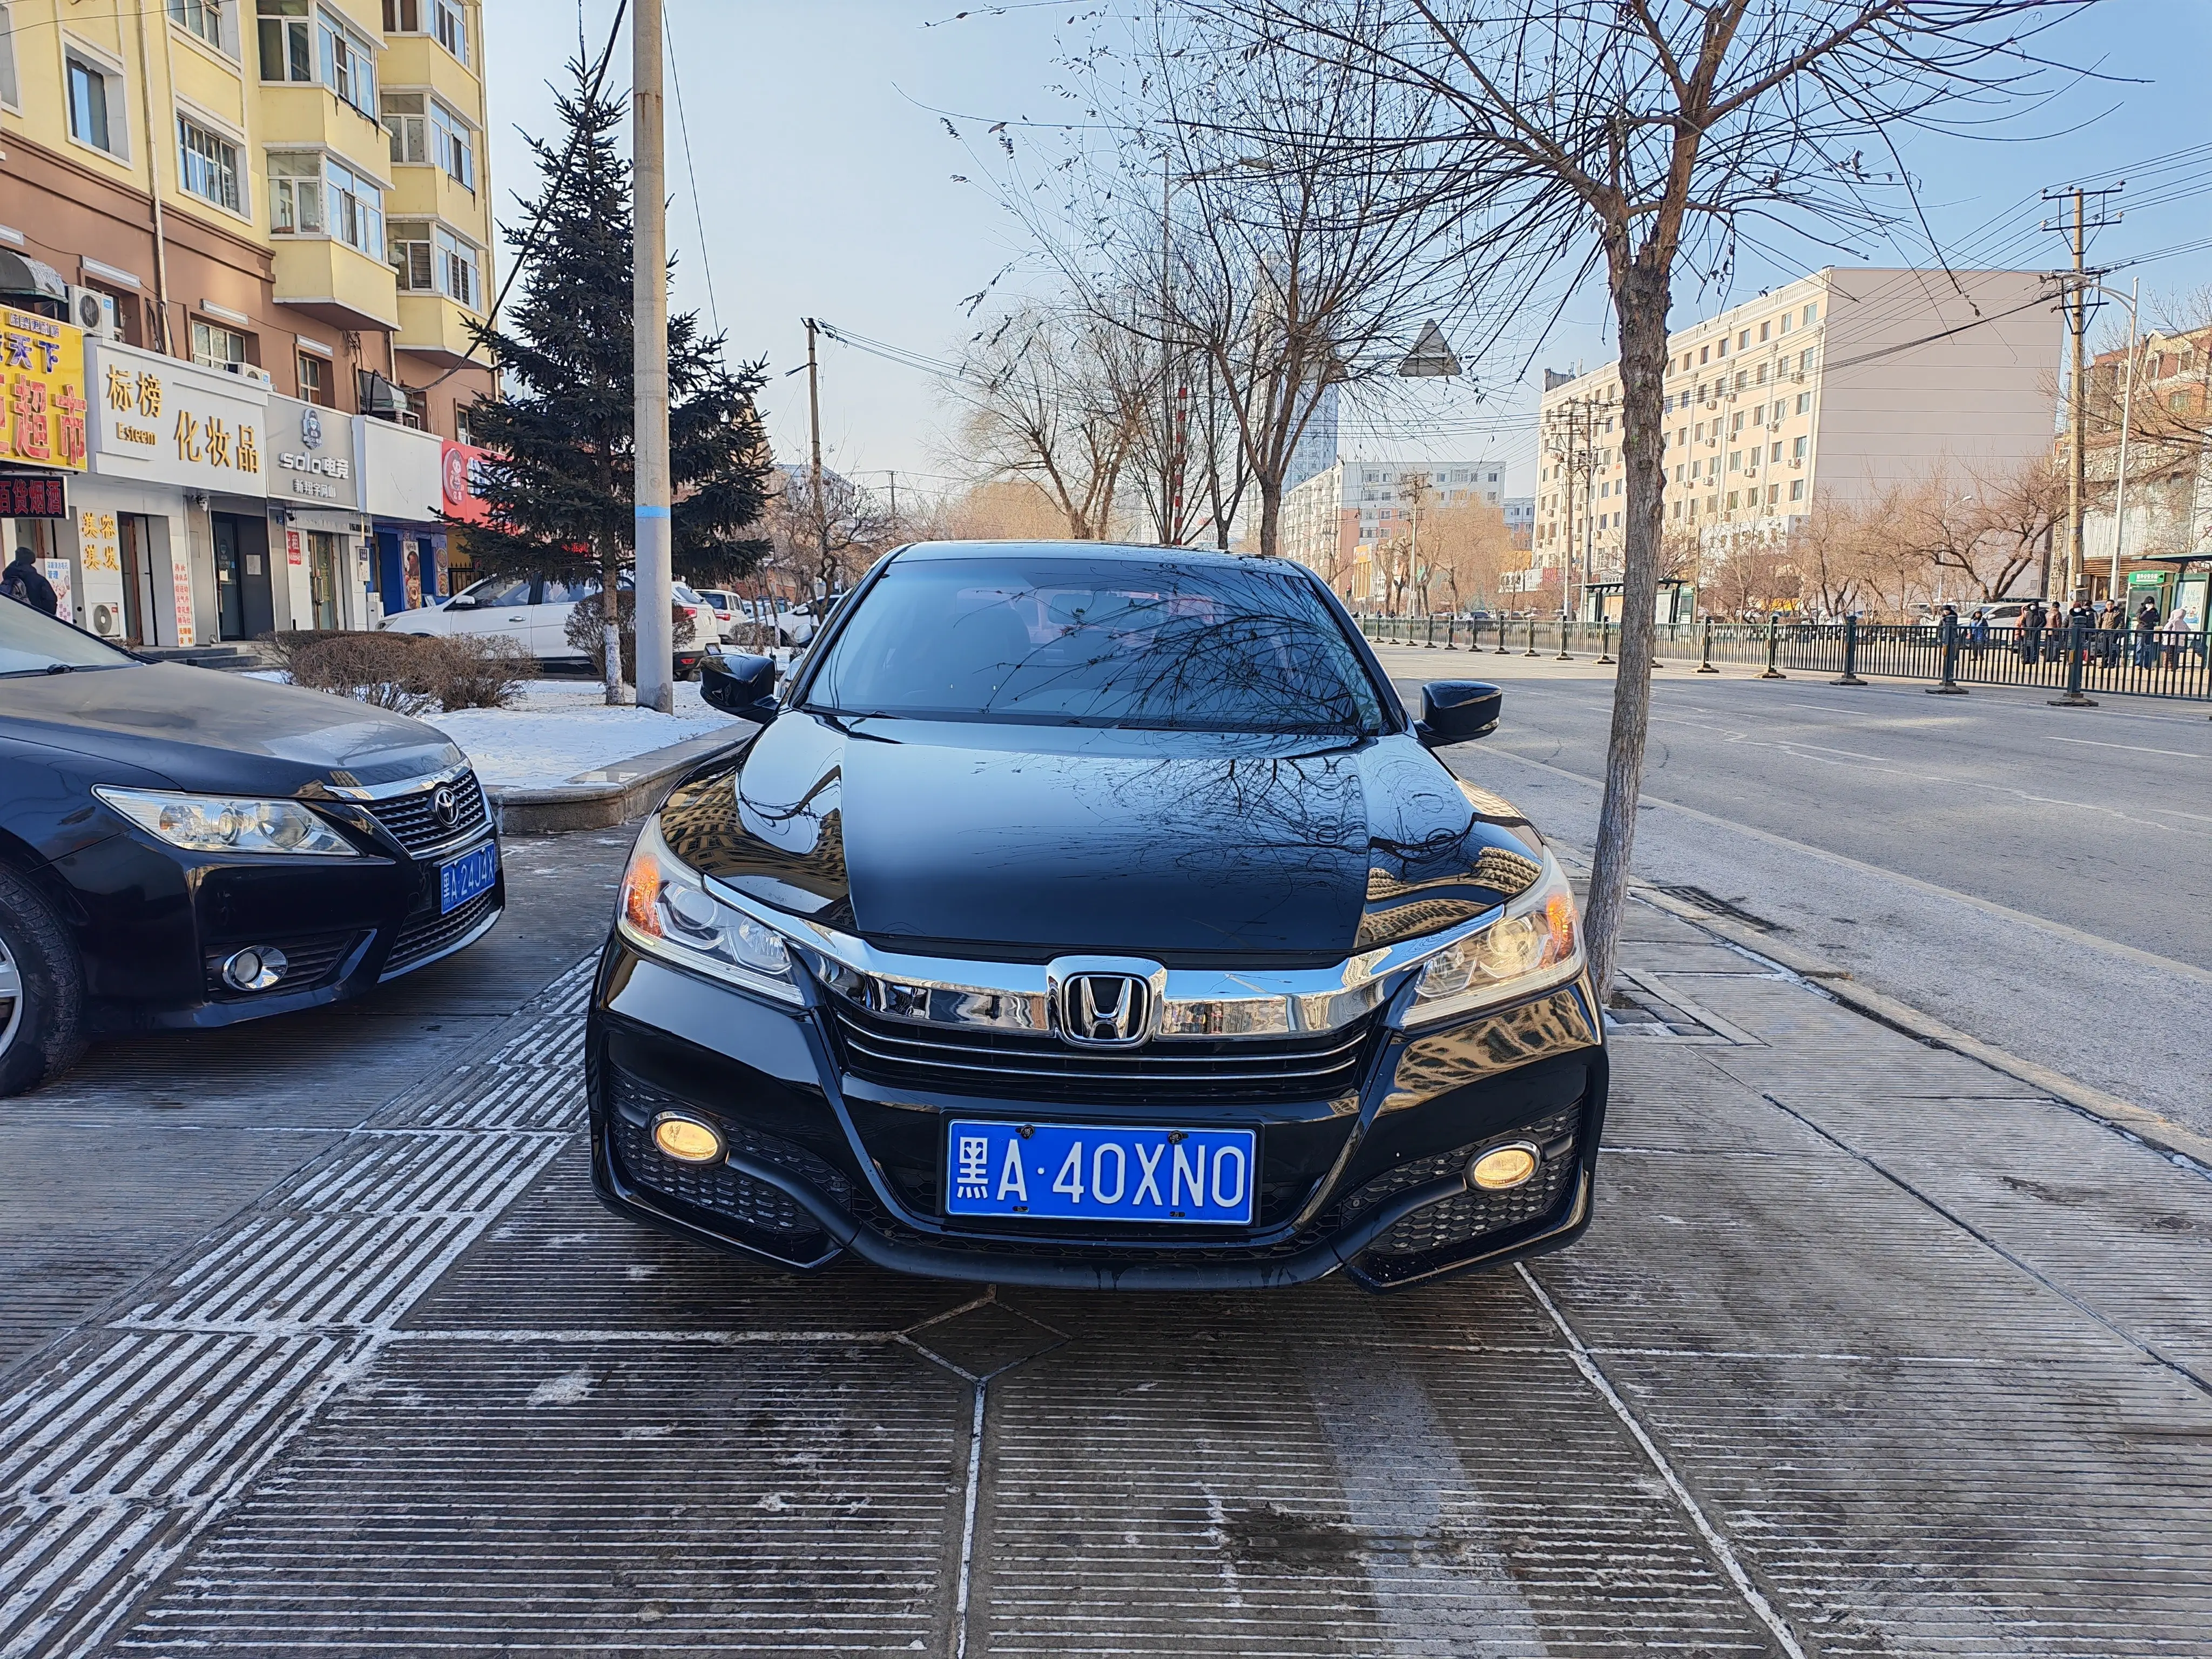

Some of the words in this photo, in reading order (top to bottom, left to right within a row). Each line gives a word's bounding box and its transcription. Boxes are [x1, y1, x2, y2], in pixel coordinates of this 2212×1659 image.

[0, 331, 60, 374] 天下
[106, 363, 163, 418] 标榜
[116, 421, 157, 446] Esteem
[173, 409, 259, 474] 化妆品
[80, 512, 117, 539] 美容
[83, 544, 119, 571] 美发
[957, 1136, 1245, 1208] 黑A·40XN0
